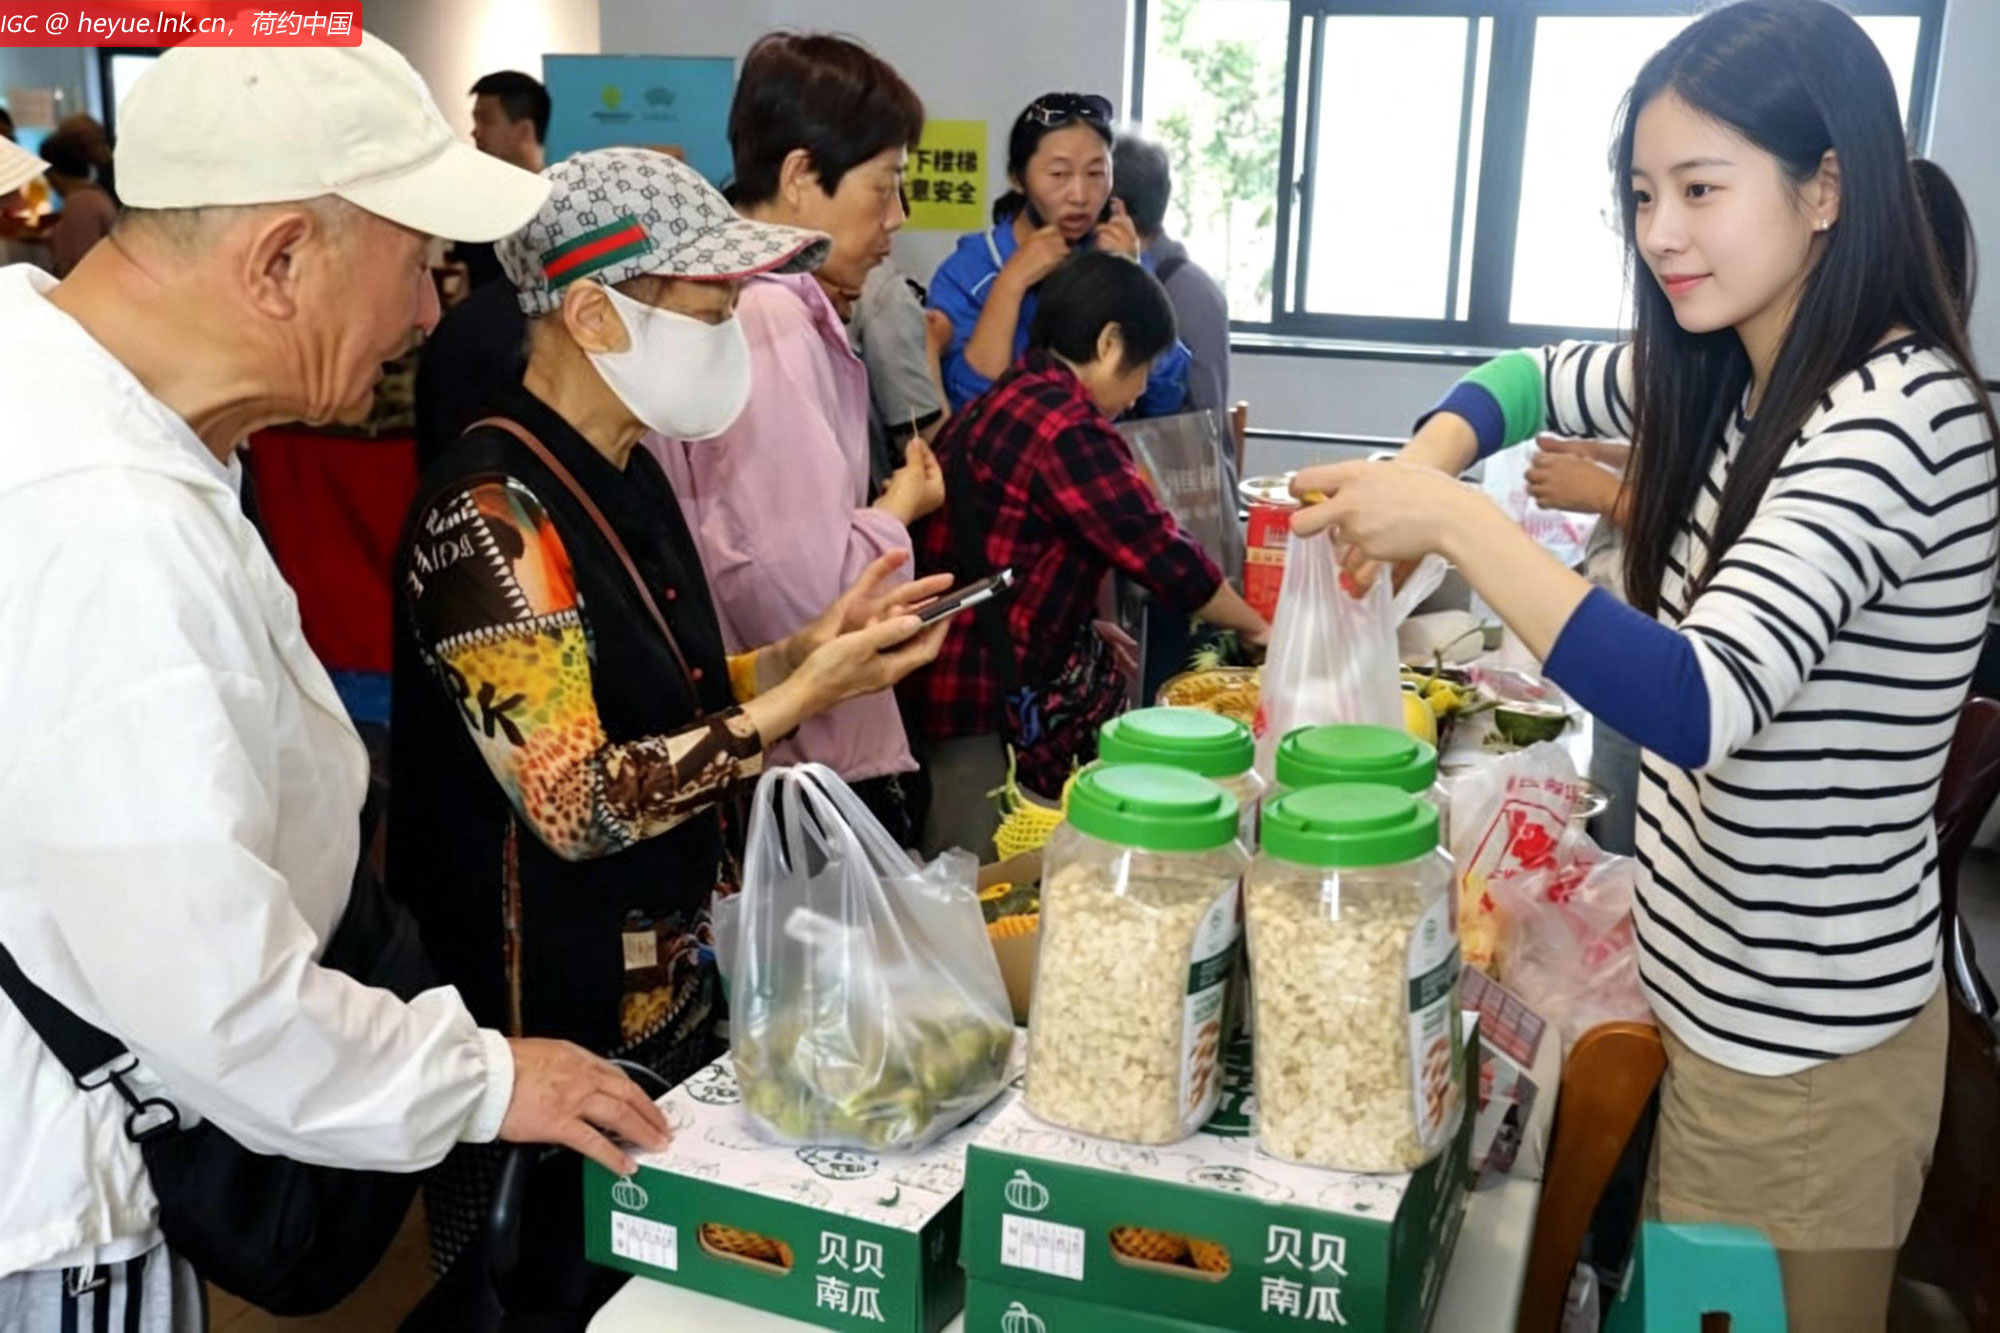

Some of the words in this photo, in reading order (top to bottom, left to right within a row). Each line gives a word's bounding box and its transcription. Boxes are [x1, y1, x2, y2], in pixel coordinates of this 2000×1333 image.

[903, 180, 977, 205] 意安全
[815, 1230, 886, 1279] 贝贝
[1263, 1224, 1349, 1278] 贝贝
[814, 1274, 886, 1323] 南瓜
[1260, 1275, 1348, 1327] 南瓜
